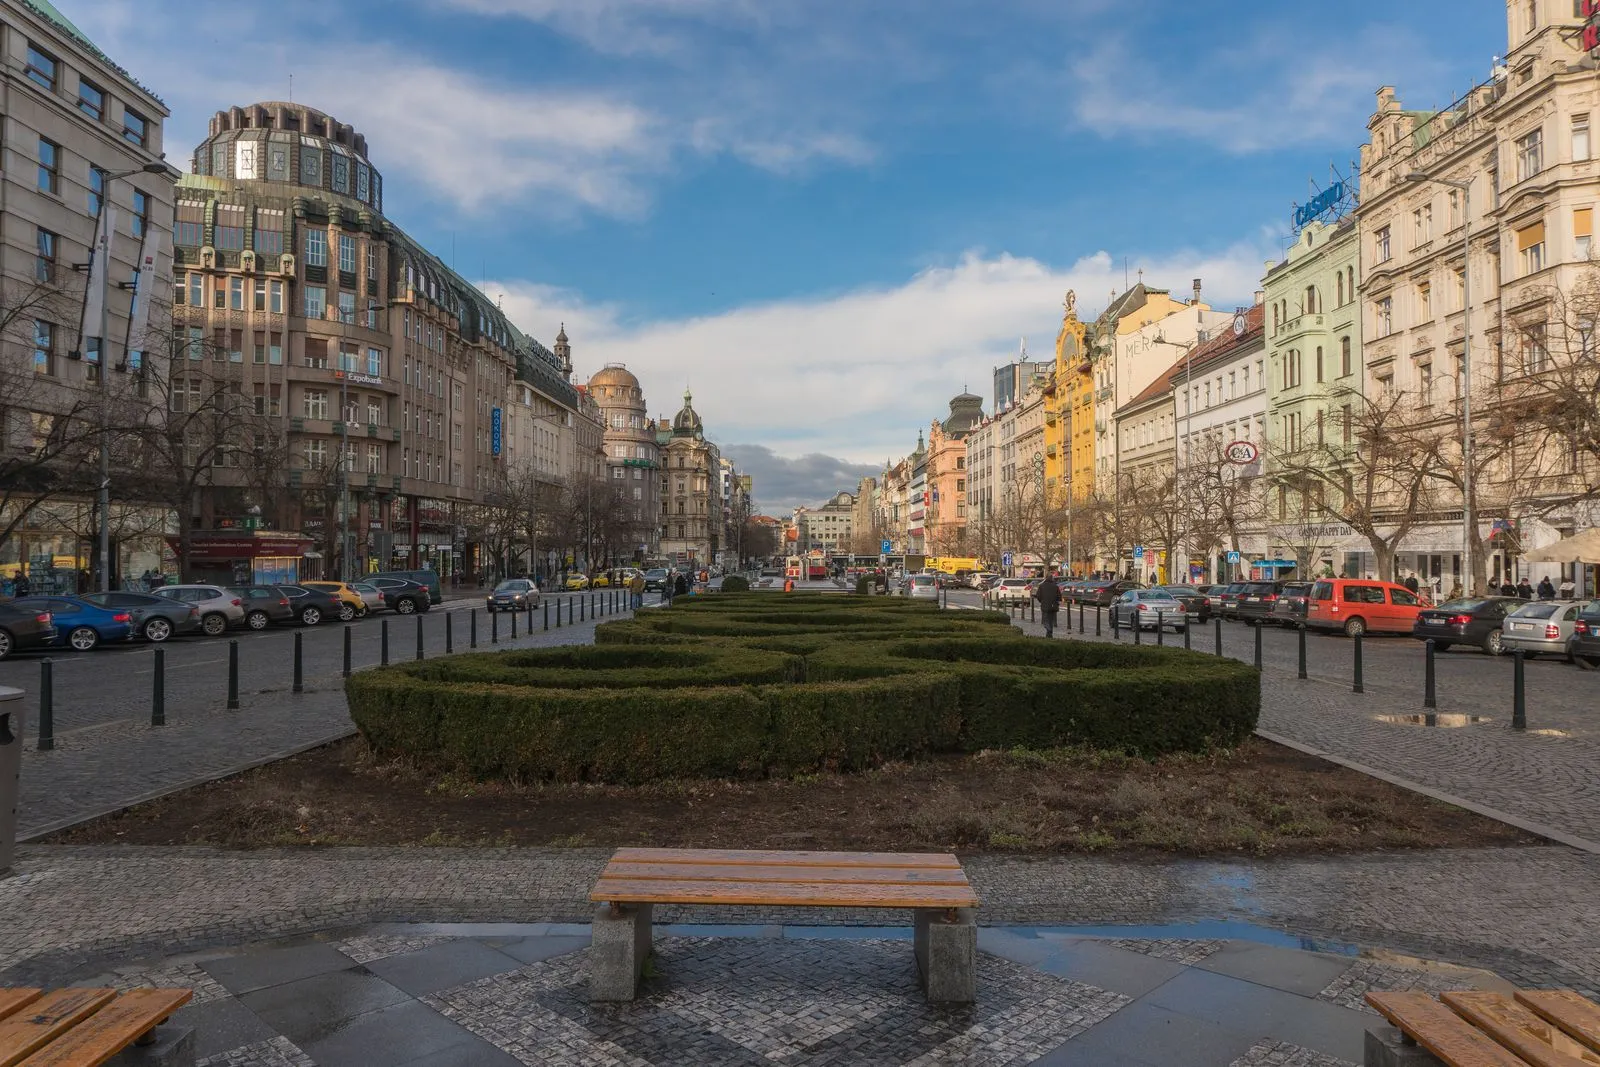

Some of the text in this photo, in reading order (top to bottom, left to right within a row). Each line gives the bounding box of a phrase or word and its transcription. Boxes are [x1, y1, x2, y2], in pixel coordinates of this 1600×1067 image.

[348, 373, 383, 385] Expobank
[1232, 446, 1253, 459] C&A
[1319, 526, 1339, 536] HAPPY
